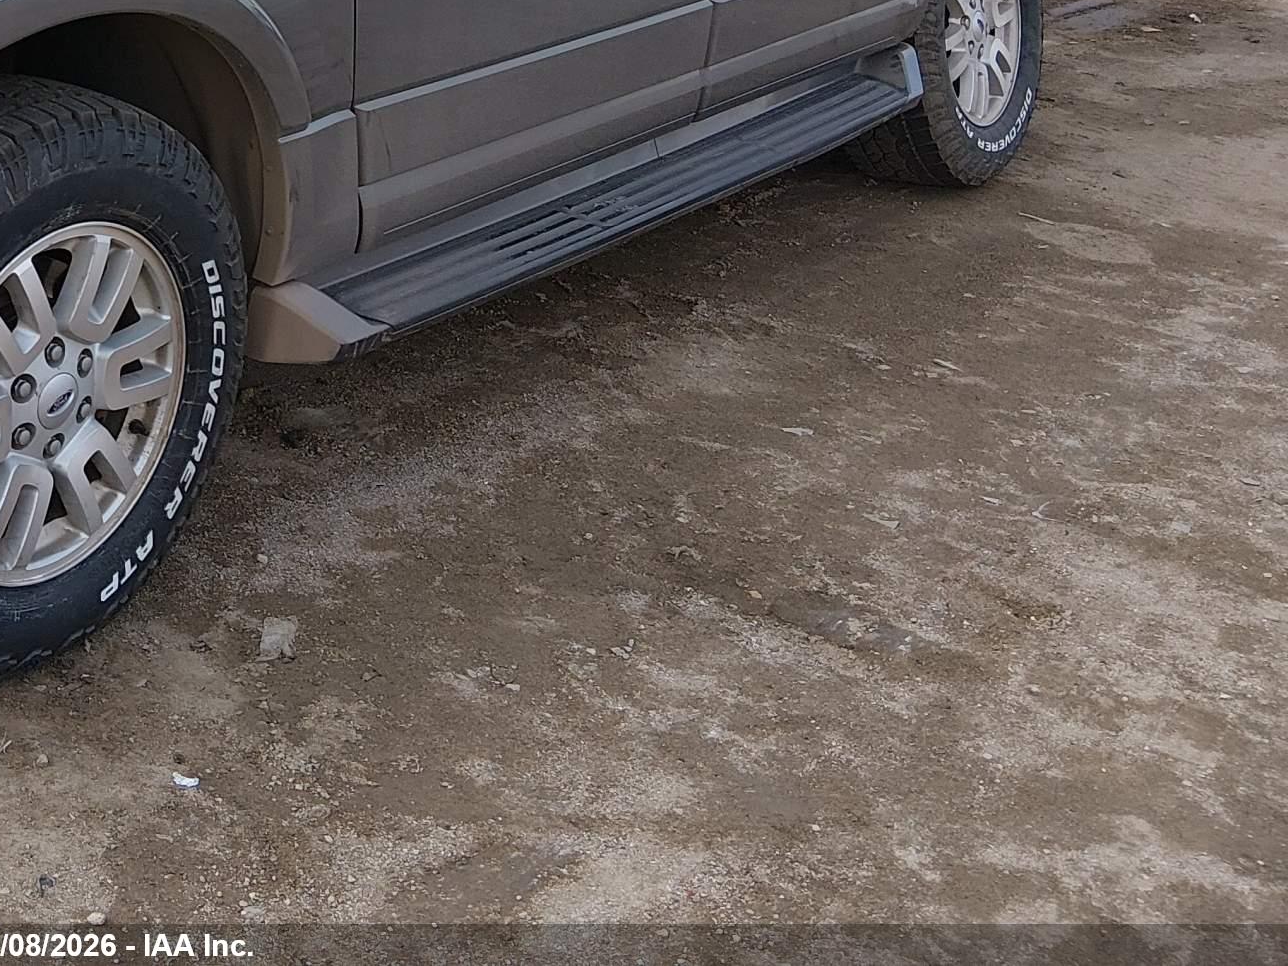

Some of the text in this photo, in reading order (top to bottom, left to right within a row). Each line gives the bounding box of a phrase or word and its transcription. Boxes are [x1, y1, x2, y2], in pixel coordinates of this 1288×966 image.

[977, 87, 1032, 152] DISCOVERER
[100, 259, 227, 602] DISCOVERER ATP
